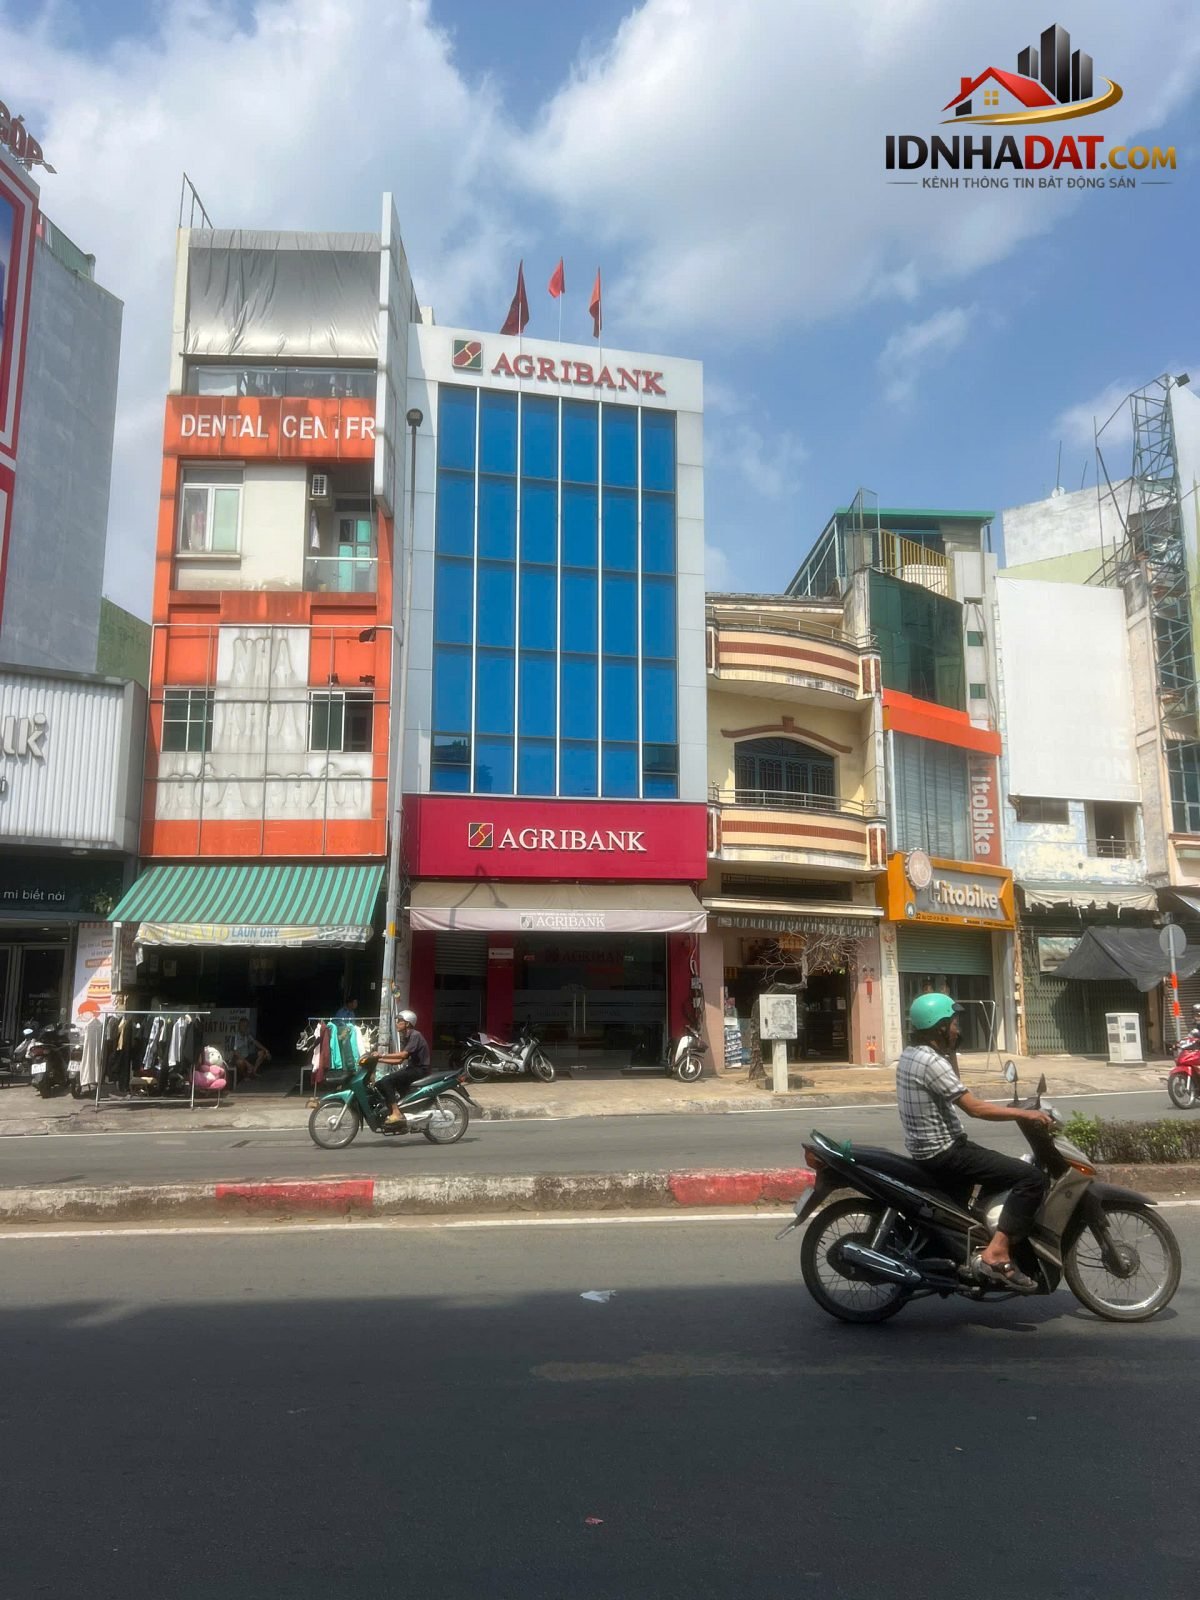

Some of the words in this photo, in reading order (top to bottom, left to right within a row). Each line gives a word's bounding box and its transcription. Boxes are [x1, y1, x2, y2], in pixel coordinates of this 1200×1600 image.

[491, 351, 666, 395] AGRIBANK
[181, 414, 269, 438] DENTAL
[498, 828, 647, 852] AGRIBANK
[231, 926, 257, 938] LAUN
[536, 915, 606, 928] AGRIBANK
